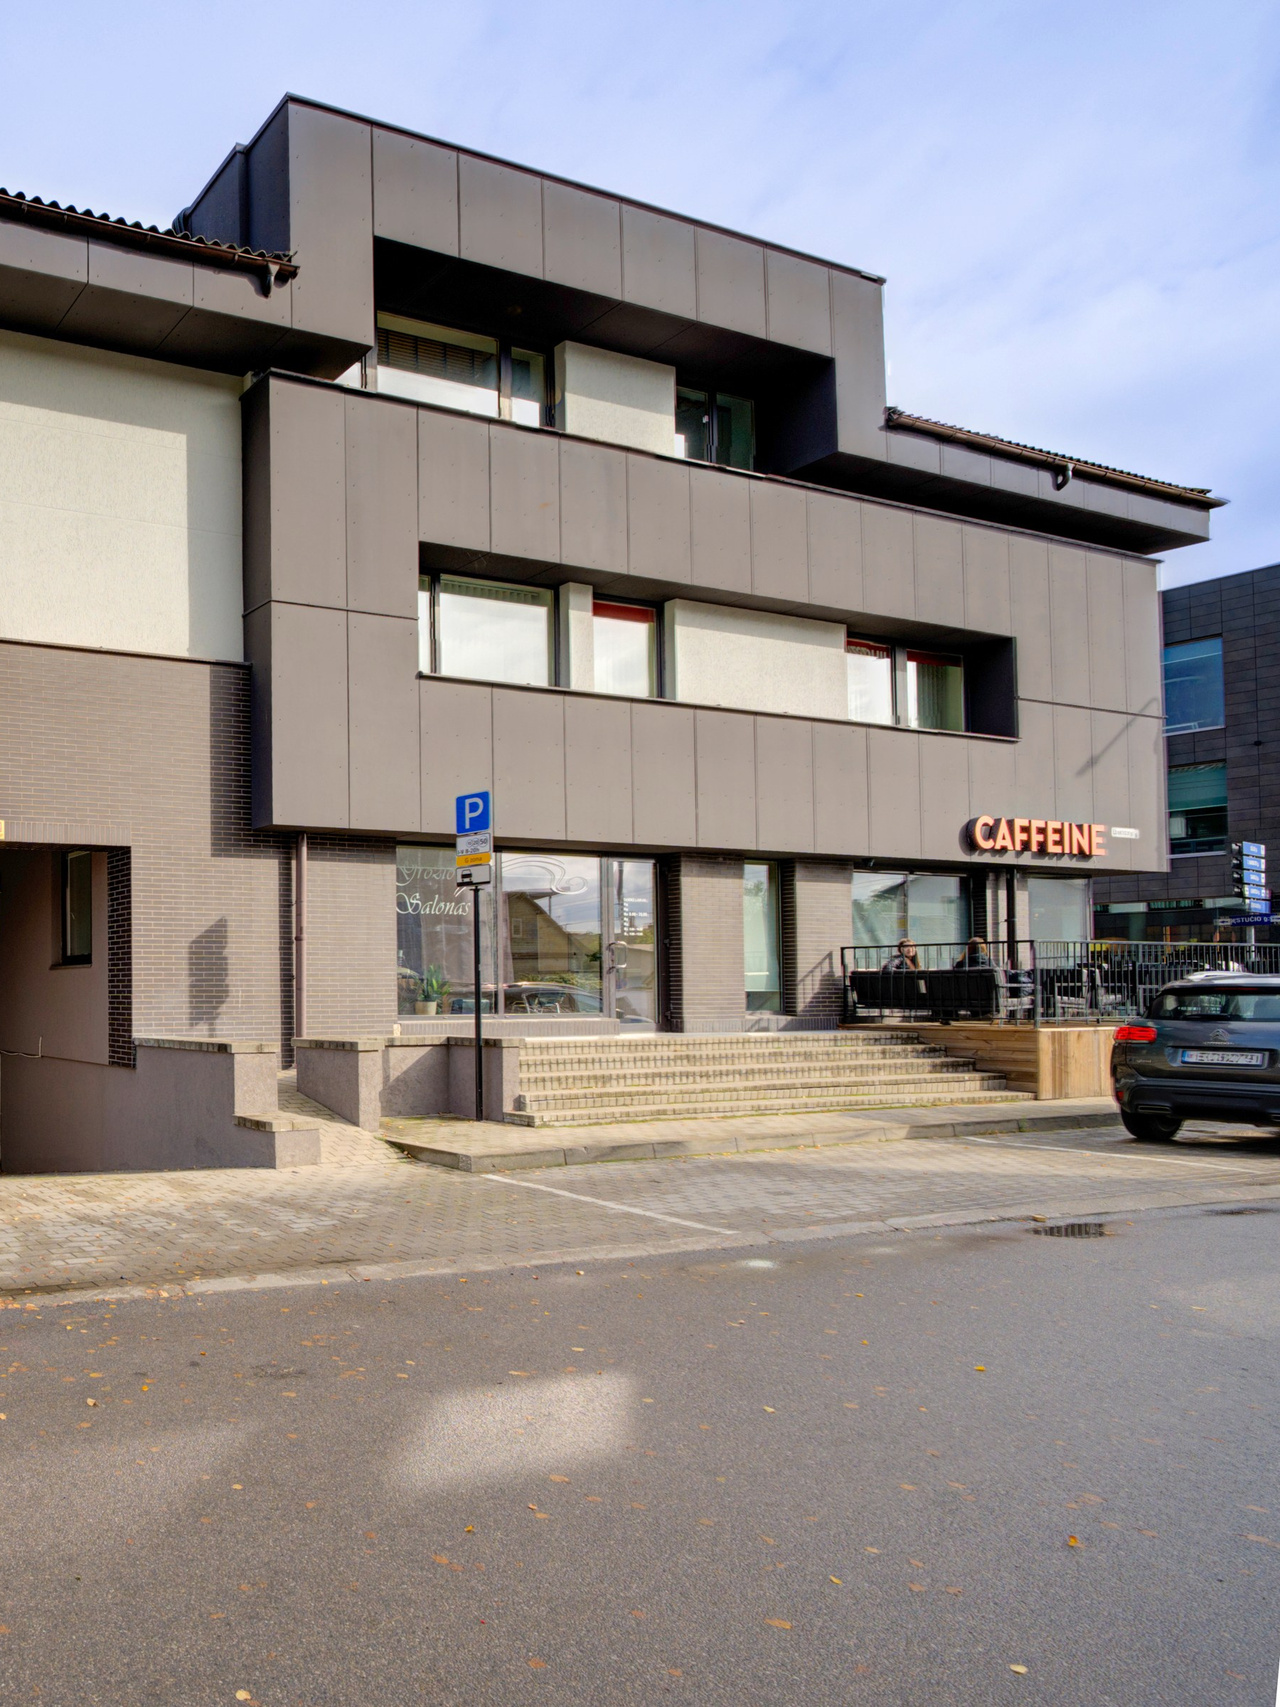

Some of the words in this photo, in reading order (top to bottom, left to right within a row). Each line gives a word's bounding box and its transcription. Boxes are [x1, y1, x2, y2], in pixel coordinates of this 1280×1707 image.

[465, 797, 484, 830] P
[479, 838, 488, 846] 50
[974, 815, 1108, 856] CAFFEINE
[396, 892, 471, 916] Salonas
